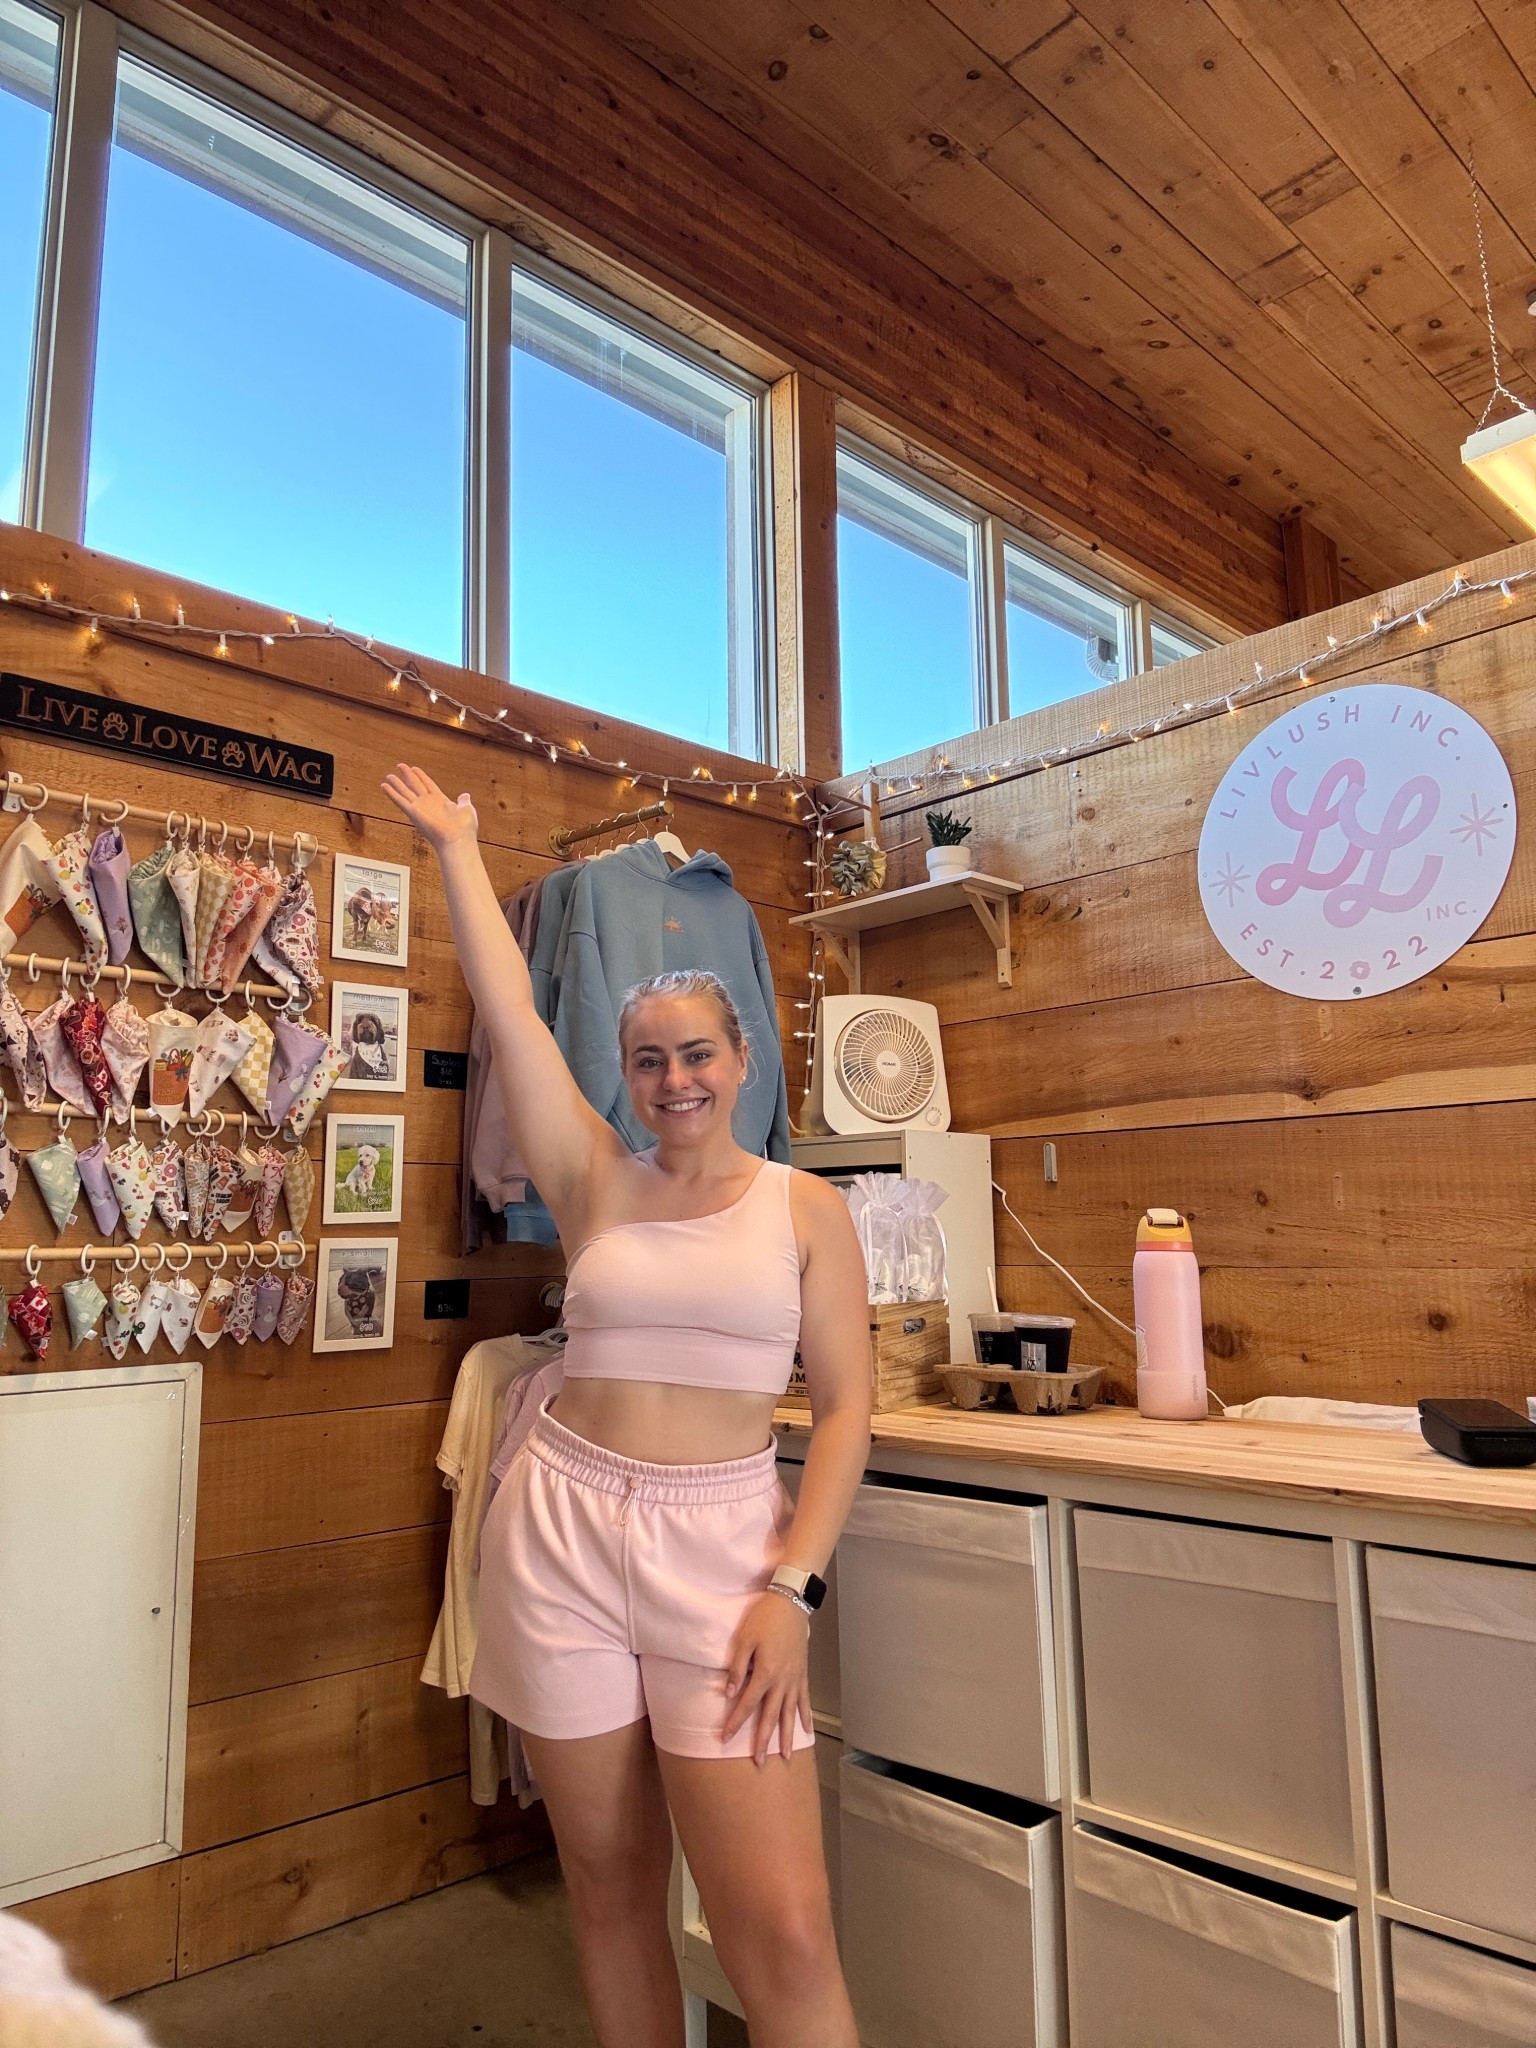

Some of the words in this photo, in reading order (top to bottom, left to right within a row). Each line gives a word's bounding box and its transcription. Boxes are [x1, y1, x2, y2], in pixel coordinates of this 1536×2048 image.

[1219, 703, 1360, 819] LIVLUSH
[1390, 704, 1462, 761] INC.
[1426, 900, 1477, 922] INC.
